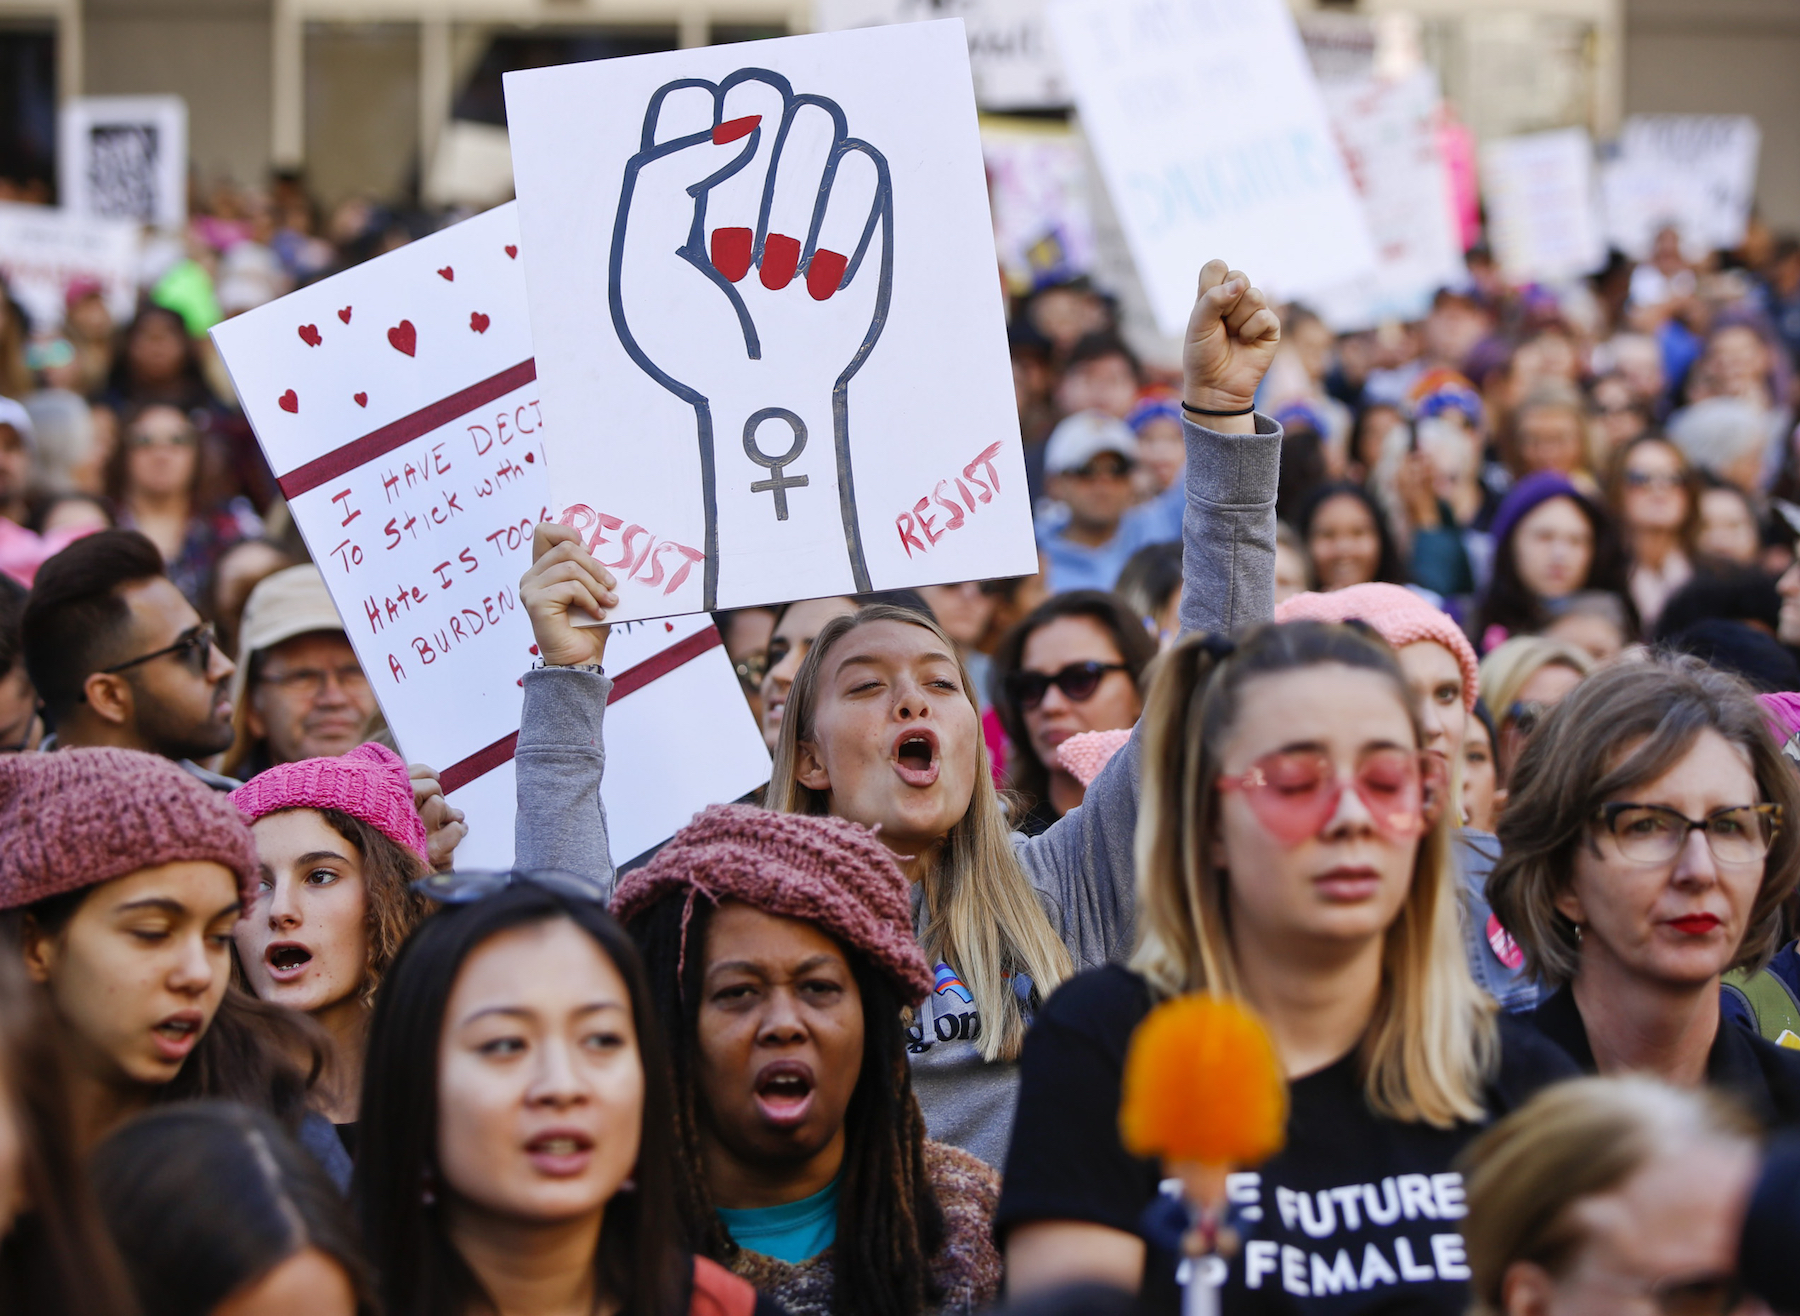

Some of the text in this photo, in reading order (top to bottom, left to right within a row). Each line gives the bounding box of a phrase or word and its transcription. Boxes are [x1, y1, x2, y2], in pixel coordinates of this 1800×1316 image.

[331, 488, 361, 528] I
[381, 442, 451, 504] HAVE
[474, 458, 524, 498] with
[895, 440, 1004, 560] RESIST
[432, 547, 479, 590] IS
[486, 518, 534, 557] TOO
[388, 585, 515, 684] A BURDEN
[1275, 1171, 1469, 1239] FUTURE
[1245, 1233, 1472, 1297] FEMALE
